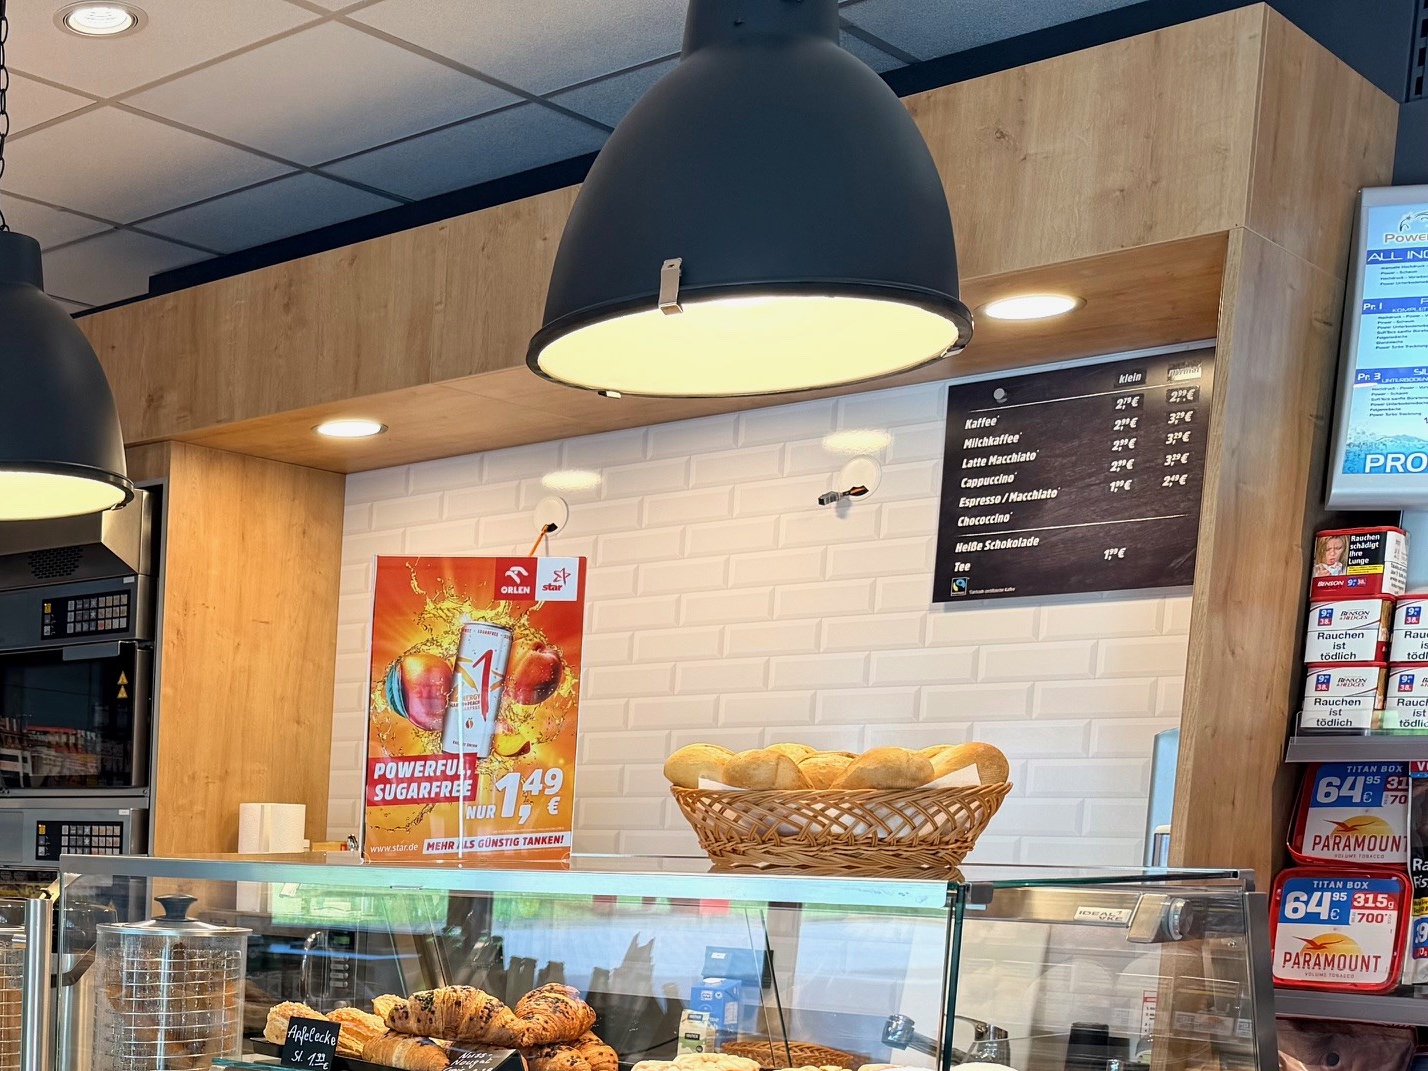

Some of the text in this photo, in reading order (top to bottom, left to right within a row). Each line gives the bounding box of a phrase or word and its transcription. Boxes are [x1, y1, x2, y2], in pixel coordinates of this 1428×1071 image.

[1368, 252, 1403, 262] ALL
[1119, 373, 1141, 384] klein
[962, 456, 987, 469] Latte
[959, 494, 1001, 508] Espresso
[1350, 534, 1380, 542] Rauchen
[955, 536, 1040, 553] Heiße Schokolade
[1350, 541, 1379, 550] schädigt
[954, 561, 971, 572] Tee
[1348, 557, 1369, 566] Lunge
[501, 586, 531, 594] ORLEN
[542, 583, 564, 592] star
[1317, 631, 1364, 640] Rauchen
[1333, 641, 1346, 650] ist
[1320, 652, 1356, 661] tödlich
[1314, 698, 1361, 707] Rauchen
[1329, 708, 1342, 716] ist
[1316, 719, 1353, 727] tödlich
[373, 758, 472, 779] POWERFUL,
[373, 780, 473, 801] SUGARFREE
[466, 805, 496, 820] NUR
[370, 842, 419, 853] www.star.de
[427, 834, 565, 851] MEHR GÜNSTIG TANKEN!
[1312, 835, 1407, 852] PARAMOUNT
[1347, 881, 1369, 889] BOX
[1353, 893, 1395, 910] 315g
[1283, 951, 1381, 973] PARAMOUNT
[287, 1024, 337, 1047] Apfelecke
